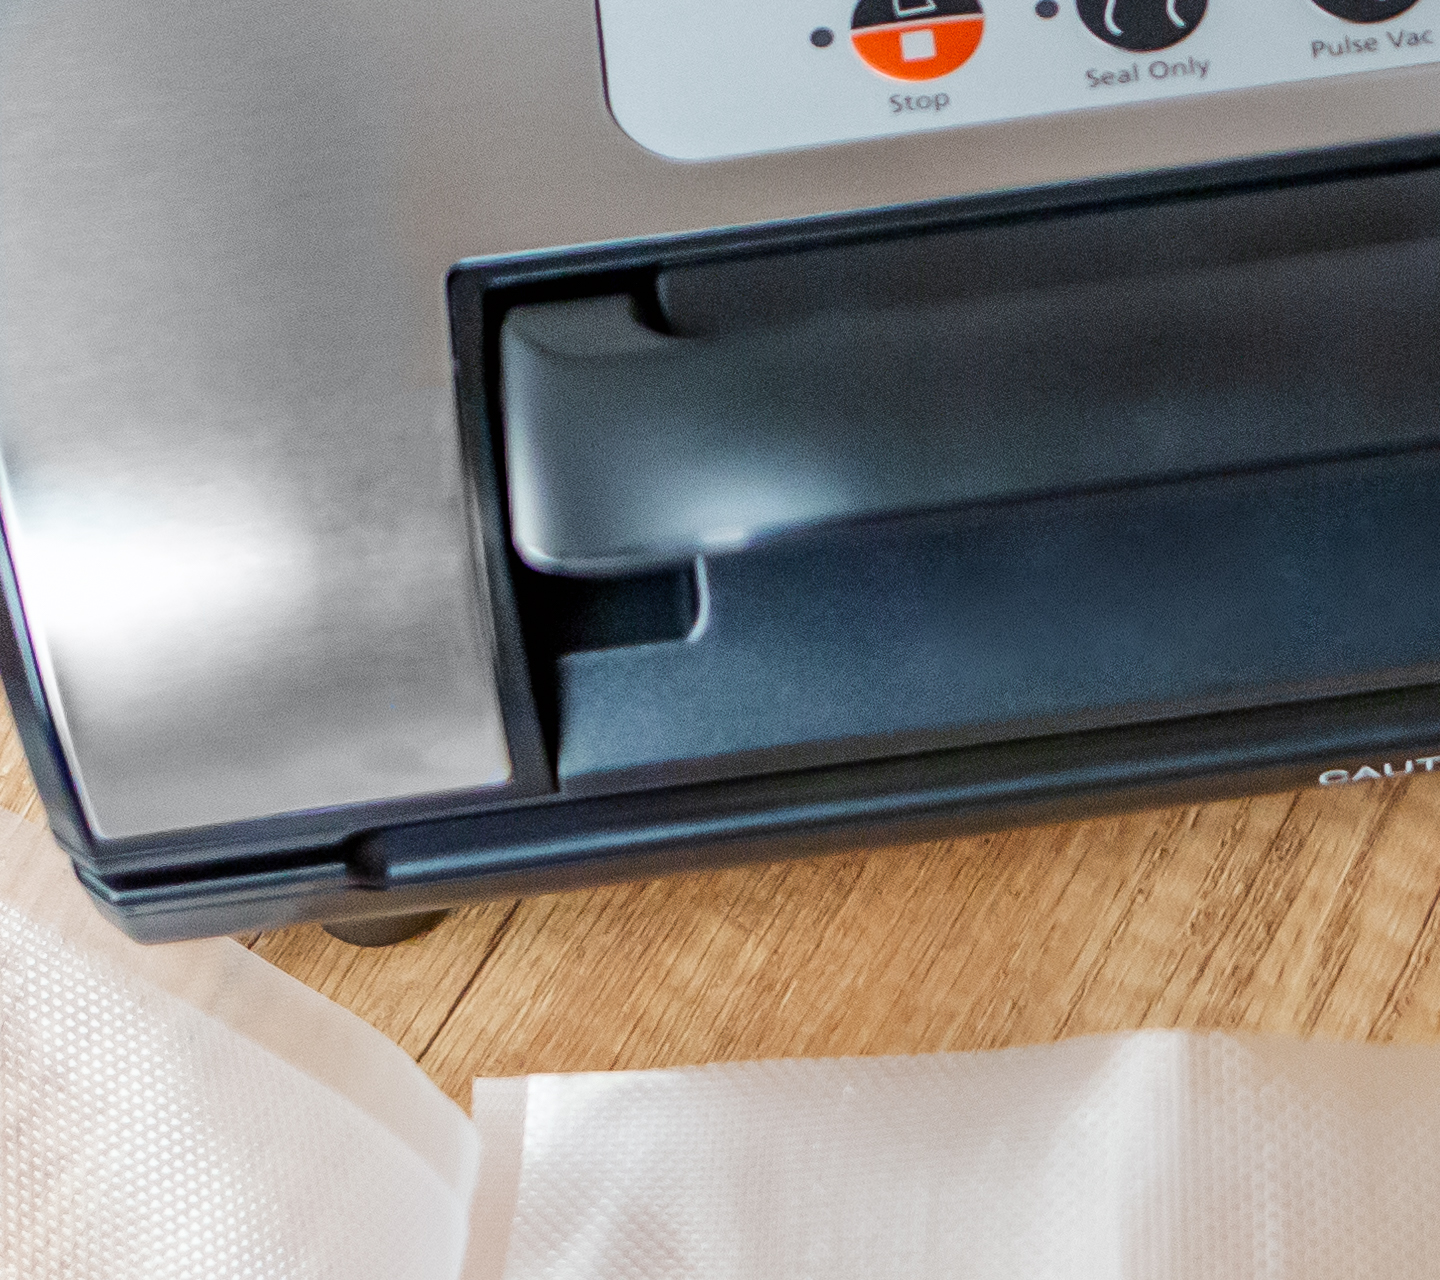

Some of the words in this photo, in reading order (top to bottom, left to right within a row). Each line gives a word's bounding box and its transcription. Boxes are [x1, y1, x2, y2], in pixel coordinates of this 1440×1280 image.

[1311, 35, 1378, 59] Pulse
[1386, 29, 1433, 49] Vac
[1085, 64, 1139, 89] Seal
[1148, 56, 1210, 80] Only
[889, 92, 951, 114] Stop
